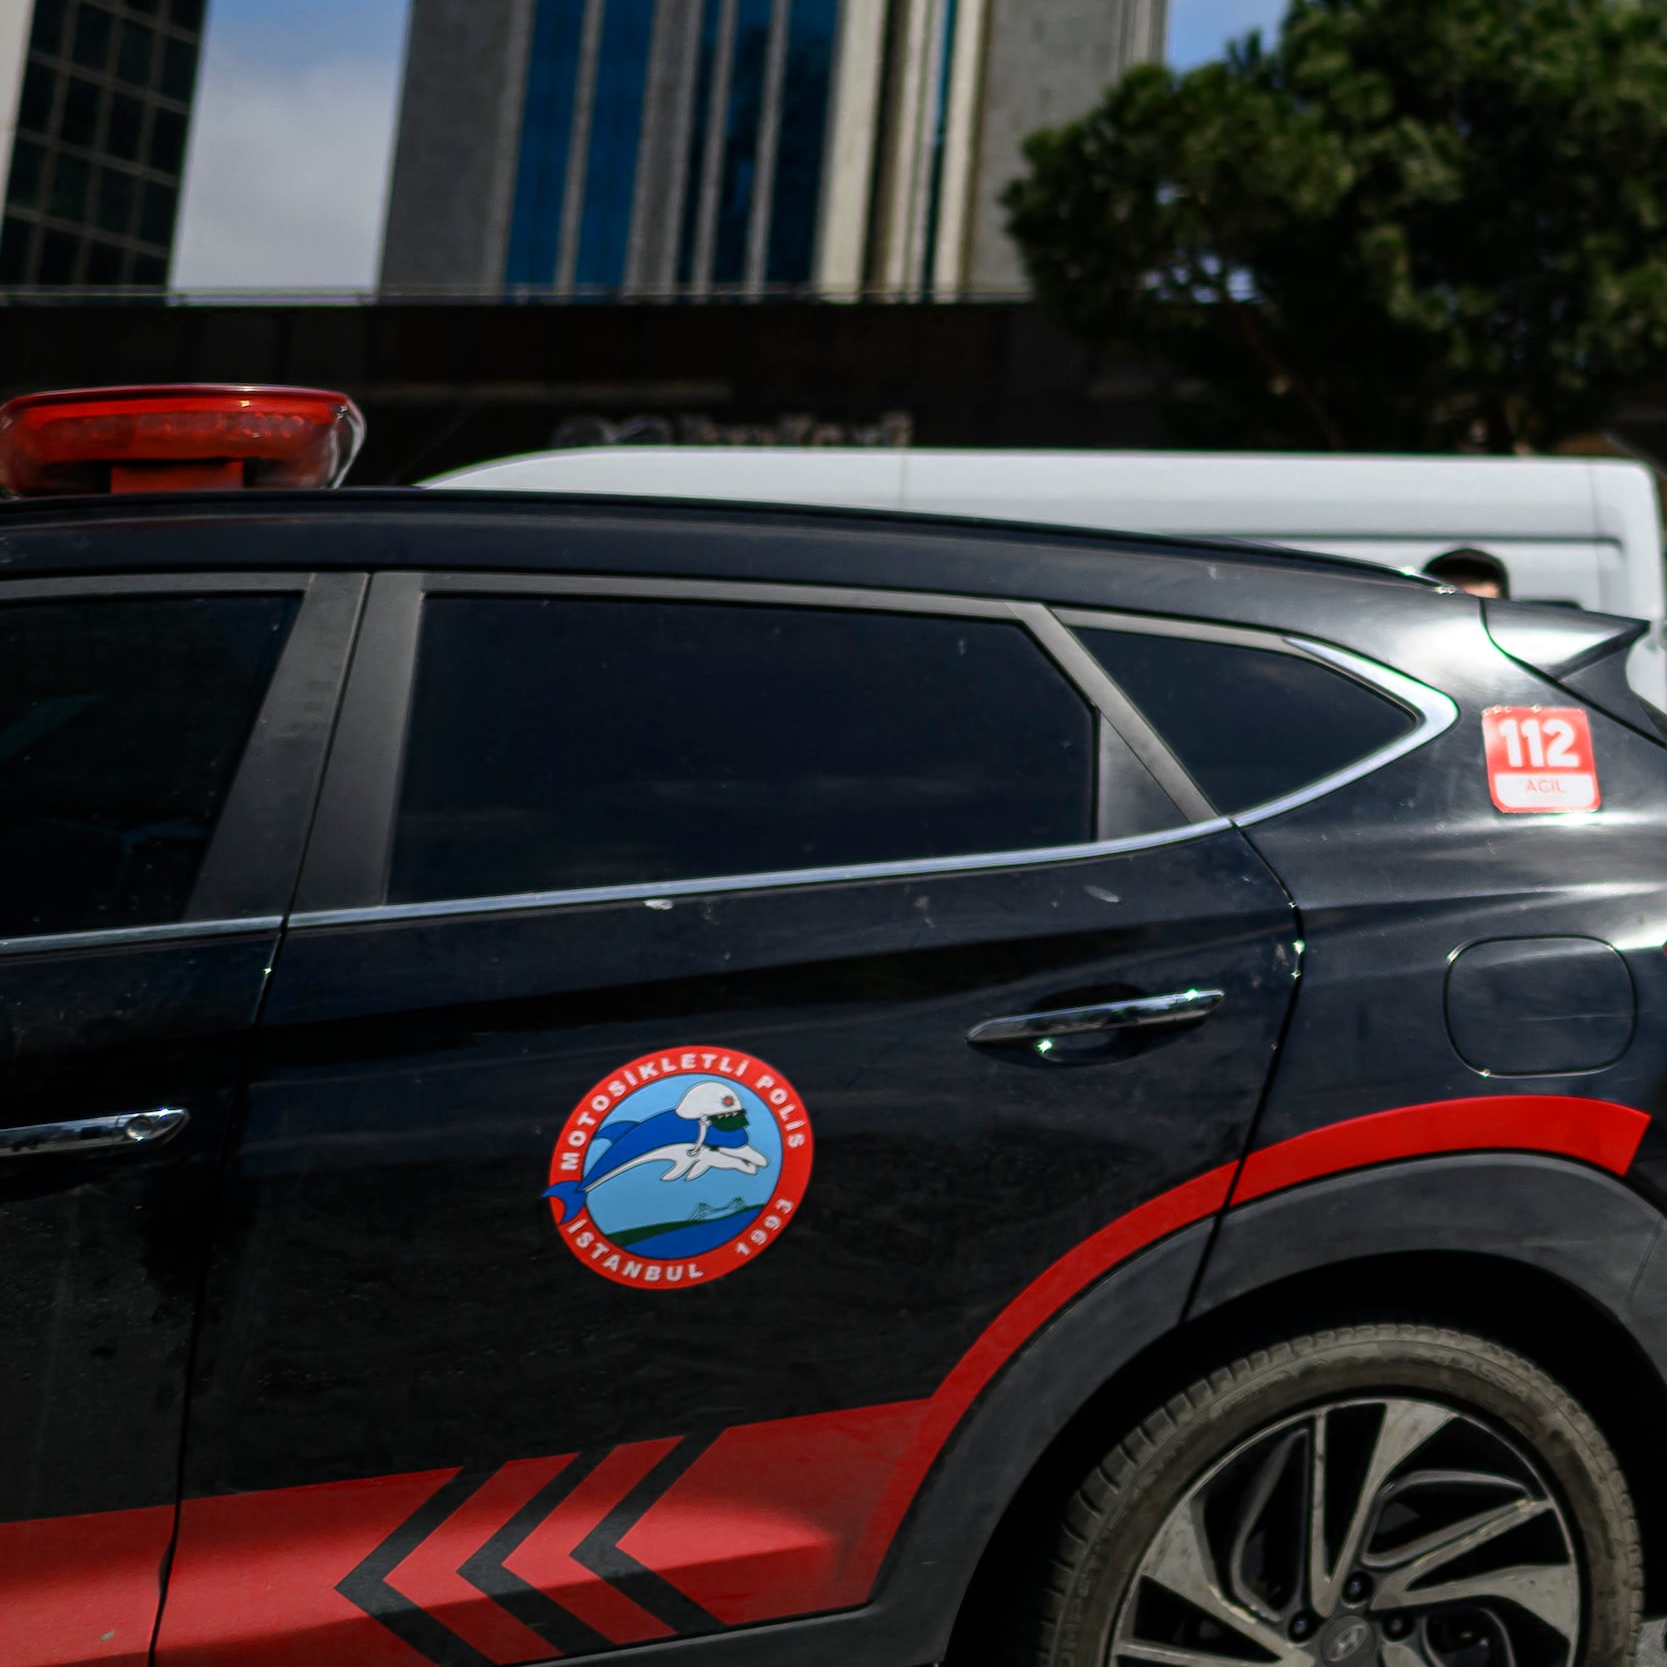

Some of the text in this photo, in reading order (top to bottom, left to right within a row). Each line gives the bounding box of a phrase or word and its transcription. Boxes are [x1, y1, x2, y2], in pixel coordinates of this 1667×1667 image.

[1499, 719, 1580, 767] 112
[560, 1053, 806, 1171] MOTOSİKLETLİ POLİS
[567, 1198, 794, 1282] İSTANBUL 1993
